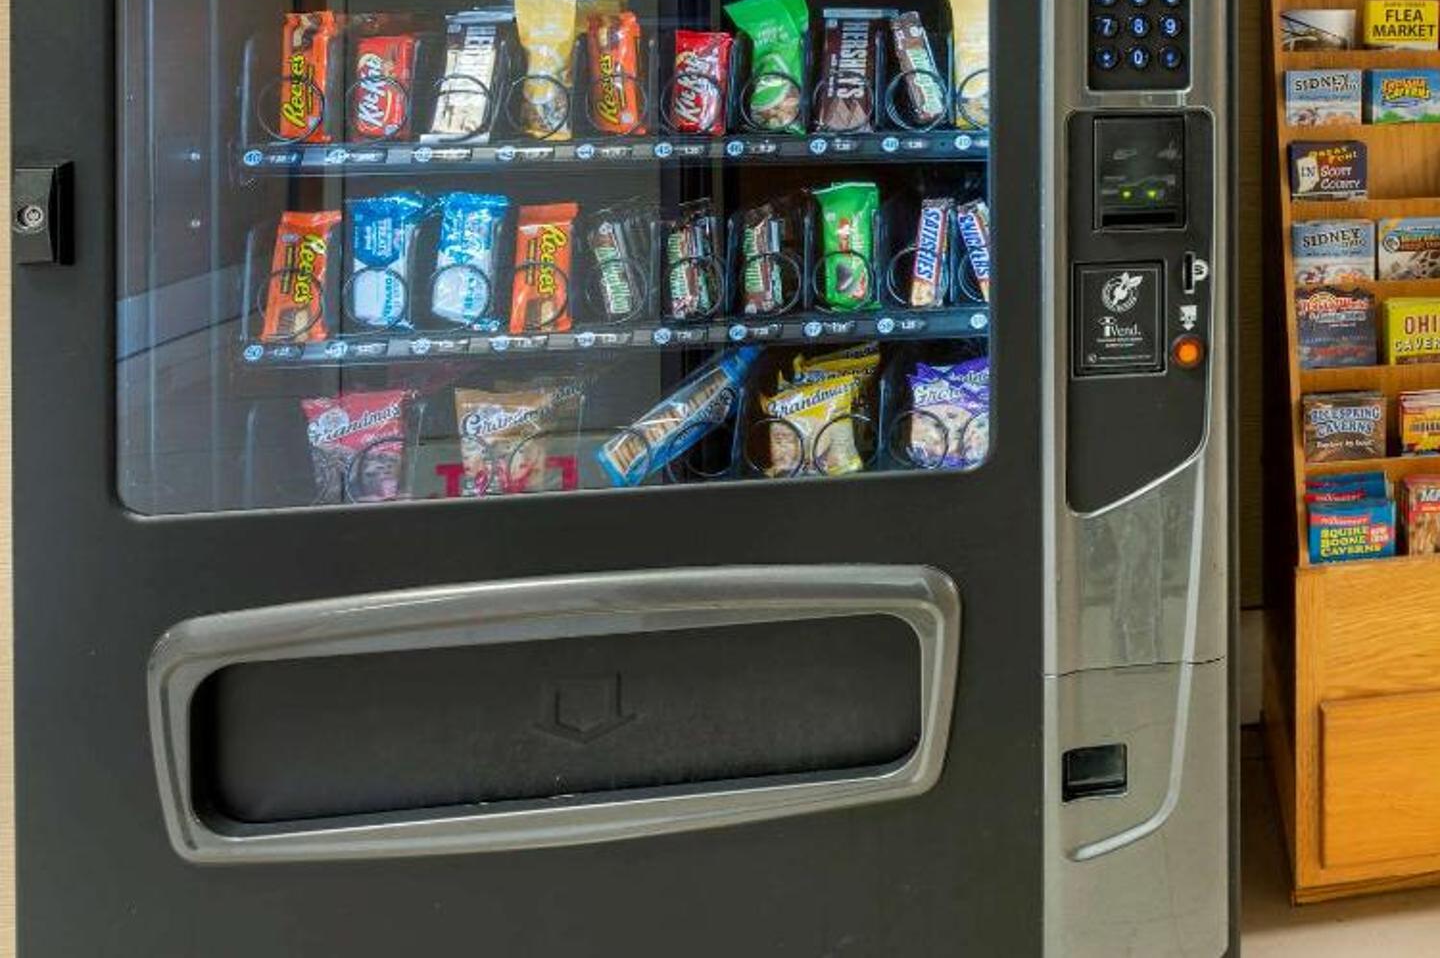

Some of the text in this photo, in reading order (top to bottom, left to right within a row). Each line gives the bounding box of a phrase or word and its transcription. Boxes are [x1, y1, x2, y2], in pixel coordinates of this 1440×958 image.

[1385, 9, 1424, 22] FLEA
[1103, 19, 1175, 33] 7 8 9
[1372, 24, 1436, 38] MARKET
[842, 20, 869, 99] HERSHEY'S
[1134, 51, 1142, 64] 0
[1295, 74, 1349, 91] SIDNEY
[919, 208, 941, 280] SATISFIES
[1303, 228, 1361, 248] SIDNEY
